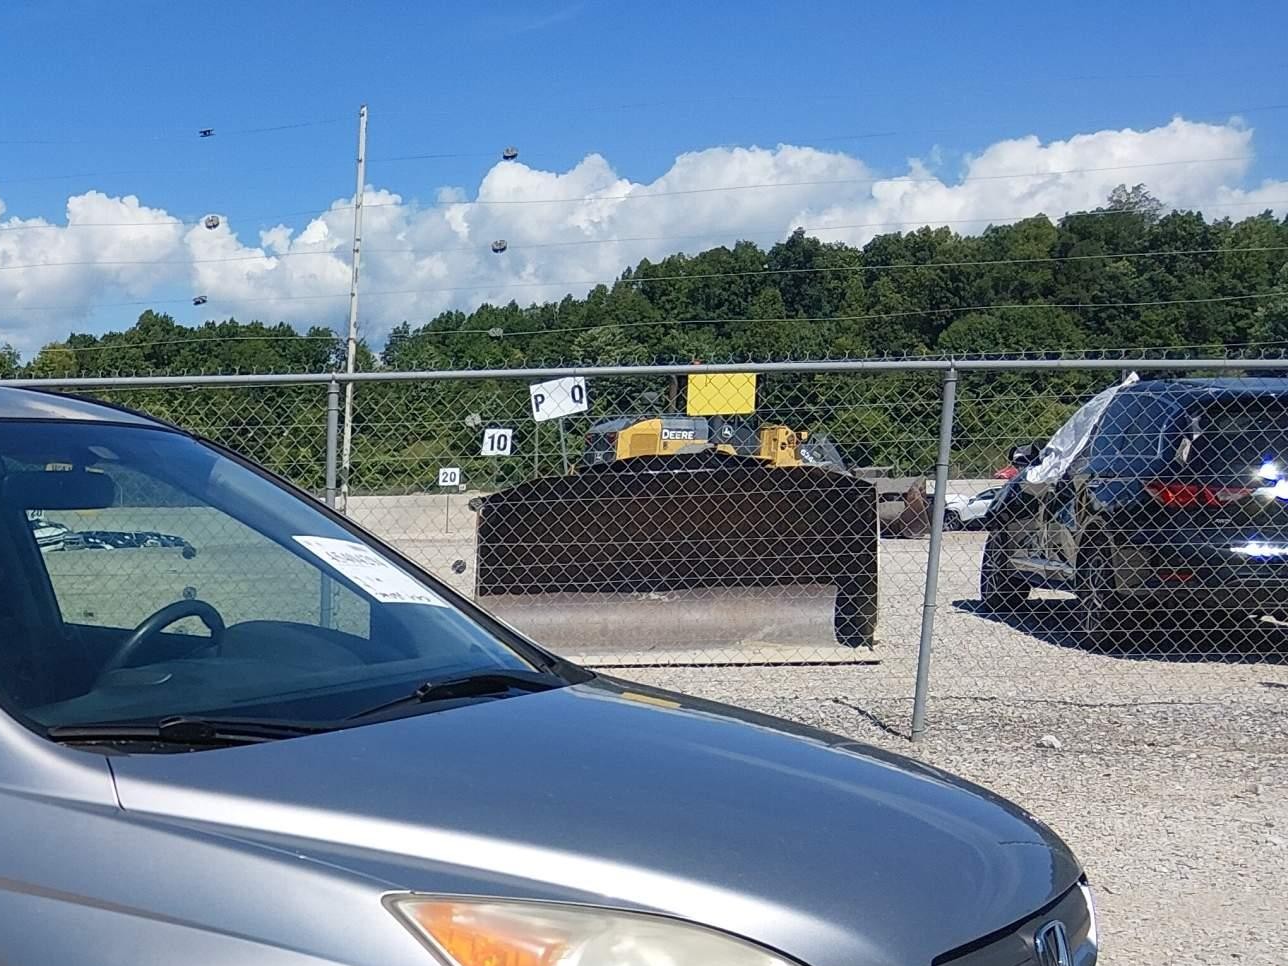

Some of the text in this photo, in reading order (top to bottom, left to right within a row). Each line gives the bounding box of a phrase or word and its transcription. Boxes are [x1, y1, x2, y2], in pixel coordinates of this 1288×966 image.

[533, 384, 584, 413] P Q
[662, 428, 695, 440] DEERE
[487, 433, 508, 452] 10
[441, 471, 457, 483] 20
